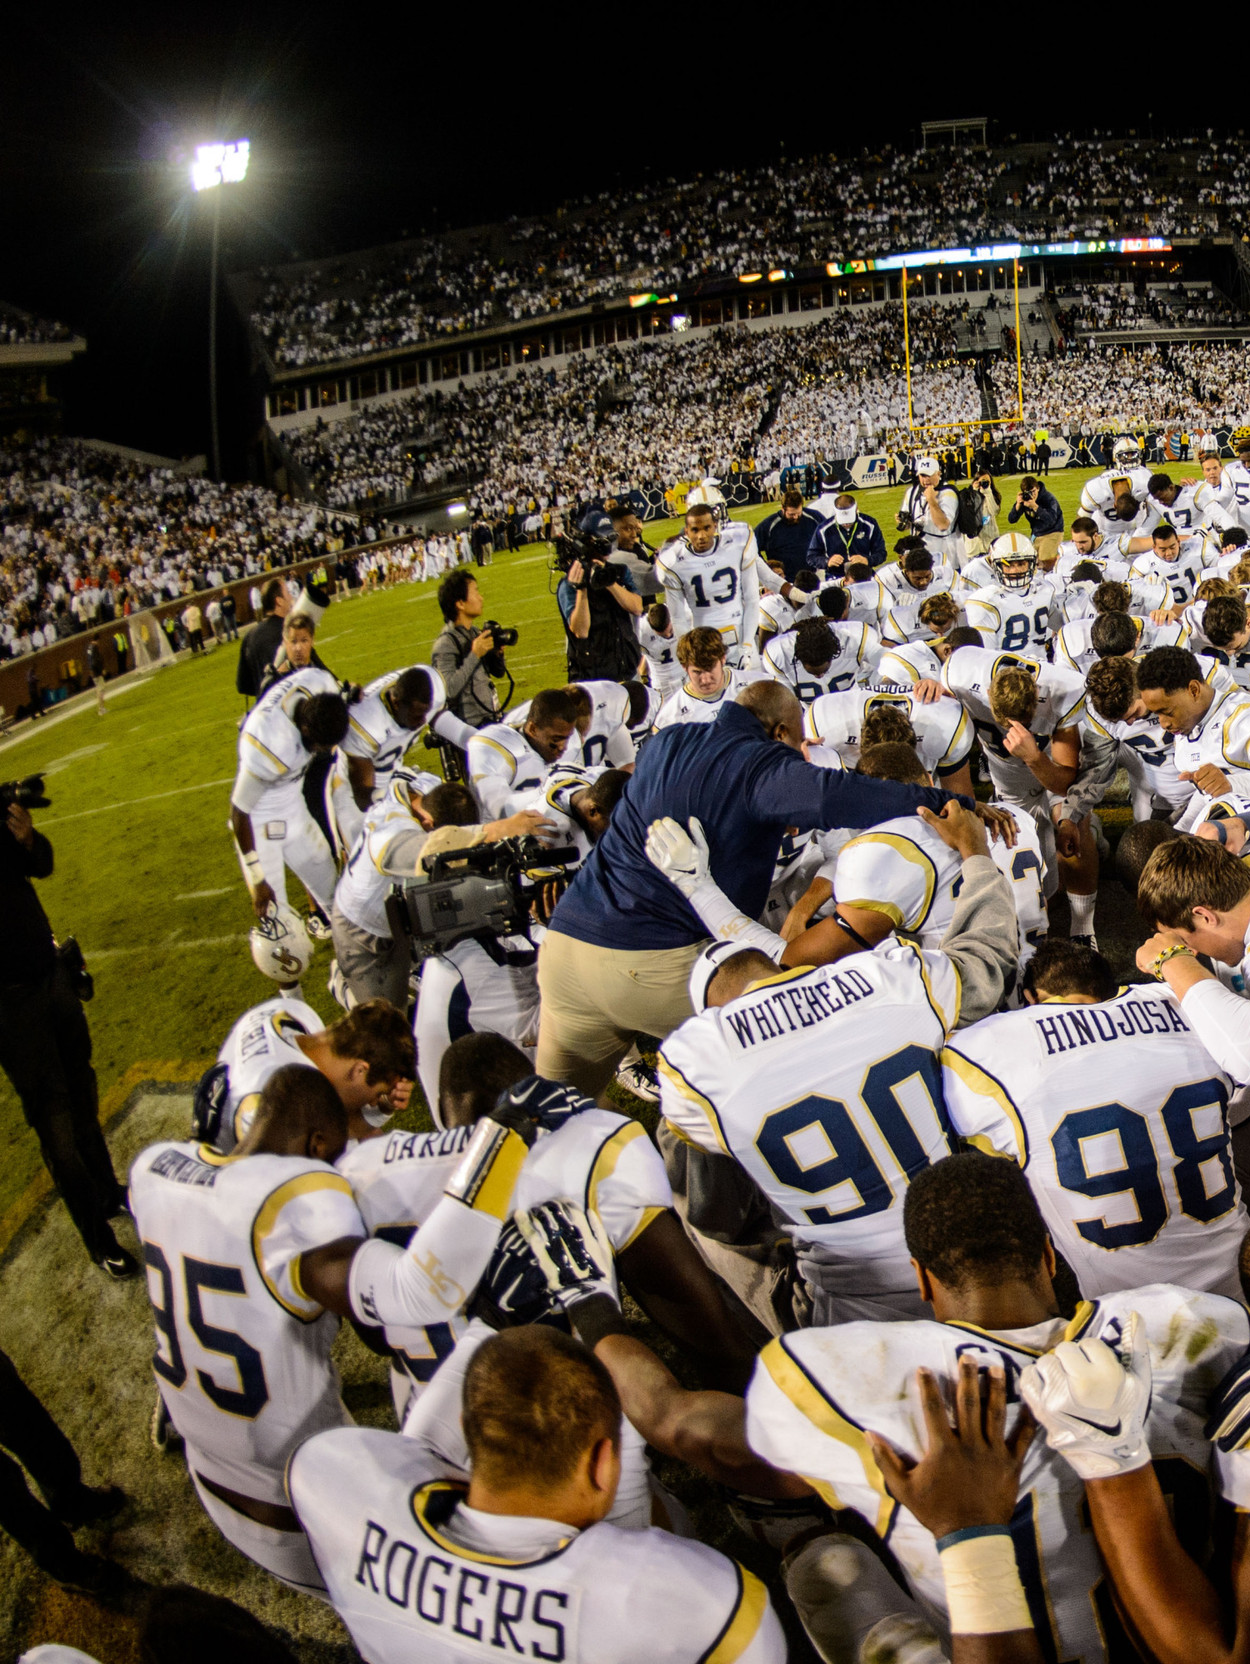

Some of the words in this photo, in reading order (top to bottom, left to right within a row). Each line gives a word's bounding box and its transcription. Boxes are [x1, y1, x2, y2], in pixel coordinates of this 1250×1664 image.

[1163, 508, 1192, 529] 17
[691, 567, 738, 607] 13
[1001, 606, 1051, 652] 89
[727, 968, 874, 1050] WHITEHEAD
[1035, 999, 1188, 1056] HINOJOSA
[755, 1043, 958, 1226] 90
[1051, 1076, 1243, 1252] 98
[144, 1240, 270, 1422] 95
[355, 1518, 569, 1663] ROGERS
